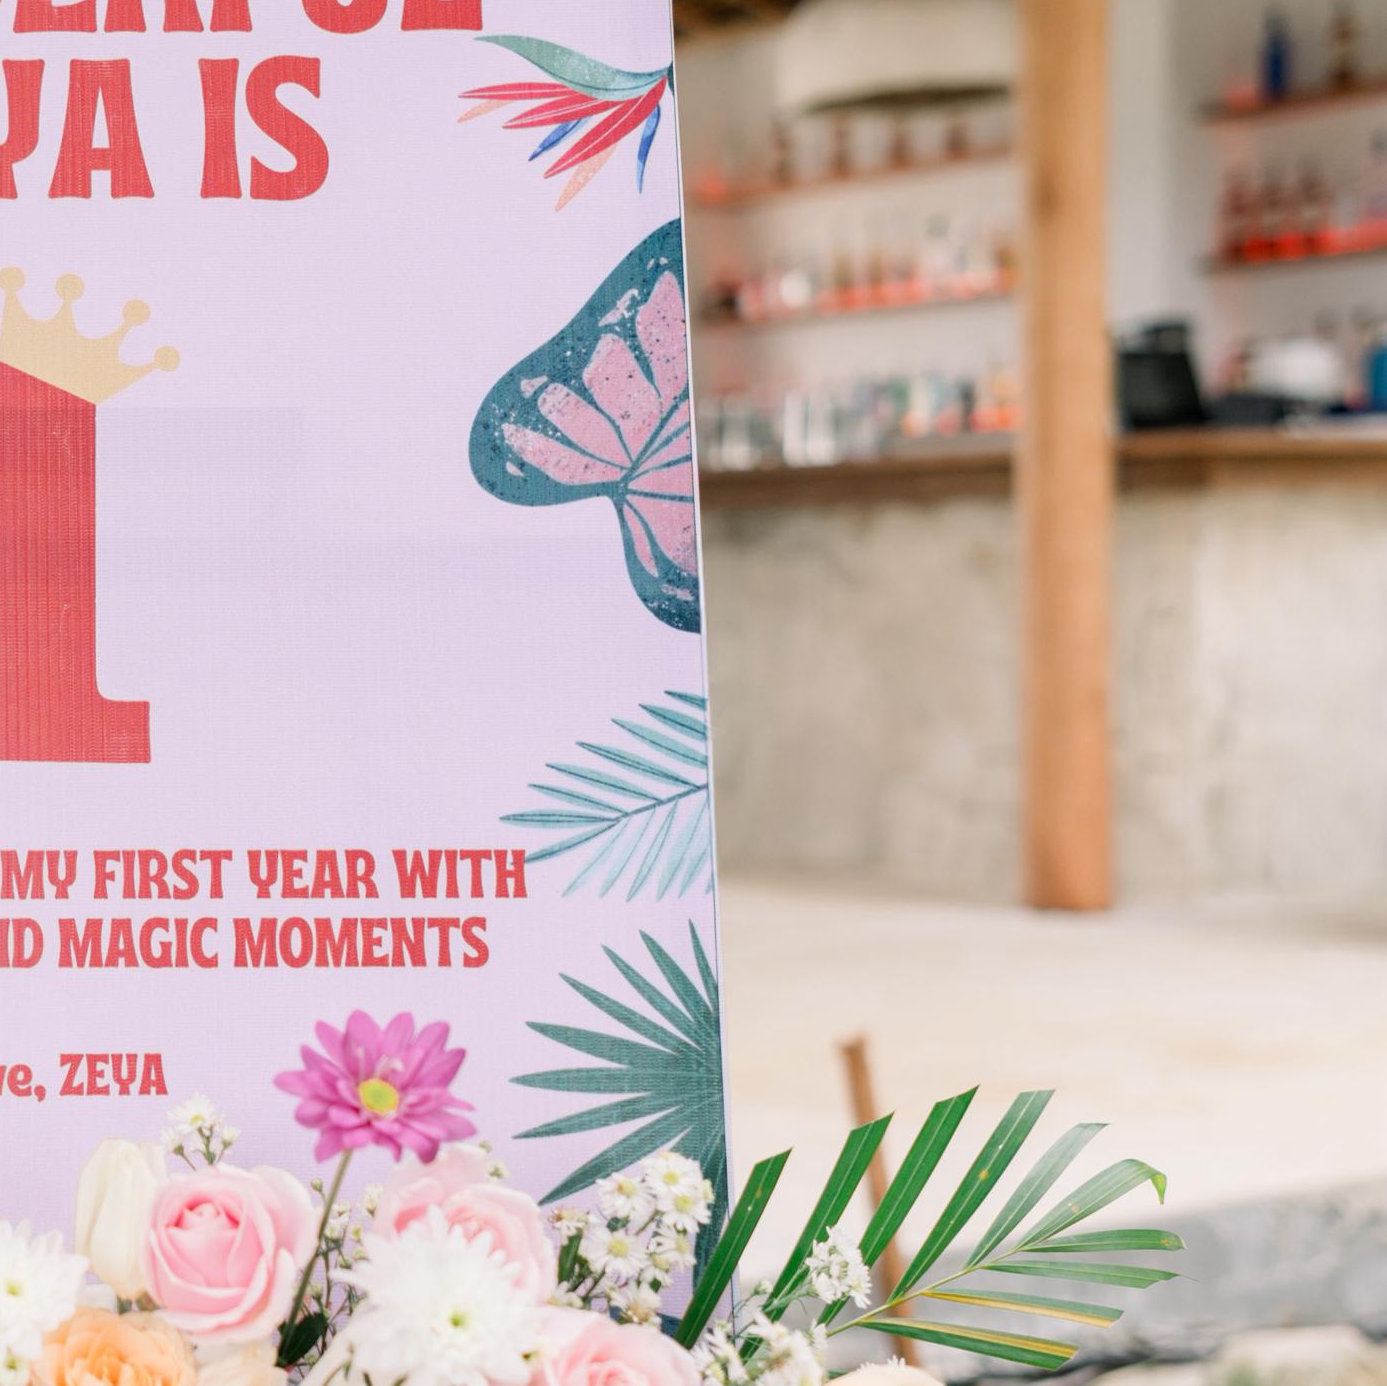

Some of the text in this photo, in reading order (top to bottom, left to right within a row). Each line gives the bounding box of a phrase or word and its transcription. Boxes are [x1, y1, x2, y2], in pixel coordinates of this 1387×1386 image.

[197, 54, 329, 201] IS
[0, 848, 78, 900] MY
[93, 848, 234, 901] FIRST
[246, 848, 380, 900] YEAR
[391, 847, 528, 899] WITH
[57, 916, 219, 969] MAGIC
[232, 916, 490, 969] MOMENTS
[58, 1051, 169, 1096] ZEYA
